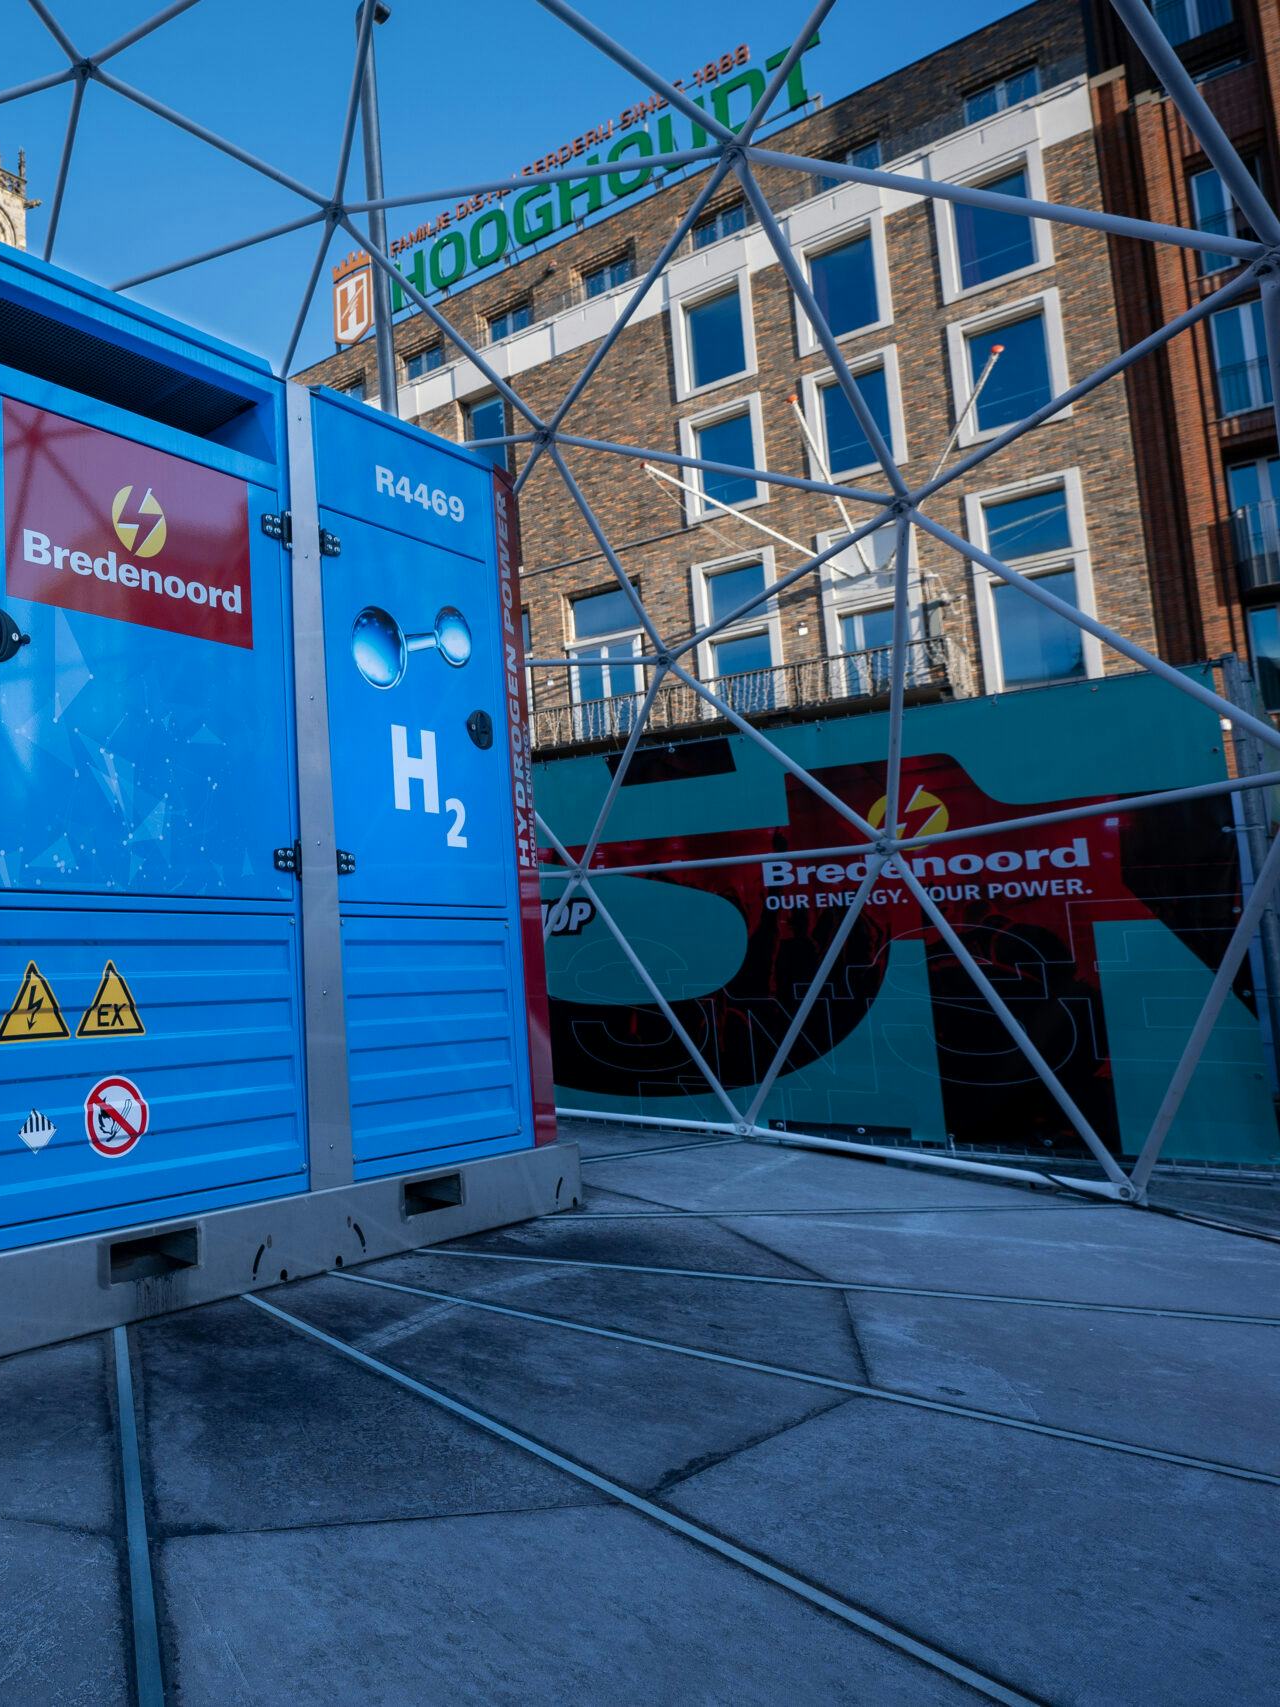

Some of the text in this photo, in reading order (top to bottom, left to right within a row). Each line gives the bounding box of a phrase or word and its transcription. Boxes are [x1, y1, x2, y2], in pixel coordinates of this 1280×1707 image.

[693, 43, 750, 88] 1888
[391, 32, 820, 313] HOOGHOUDT
[375, 464, 465, 523] R4469
[23, 529, 243, 614] Bredenoord
[496, 491, 530, 867] HYDROGEN POWER
[761, 837, 1090, 887] Bredenoord
[541, 902, 592, 932] OP
[765, 894, 810, 910] OUR
[815, 888, 909, 908] ENEGY.
[987, 878, 1093, 899] POWER.
[97, 1003, 127, 1027] EX
